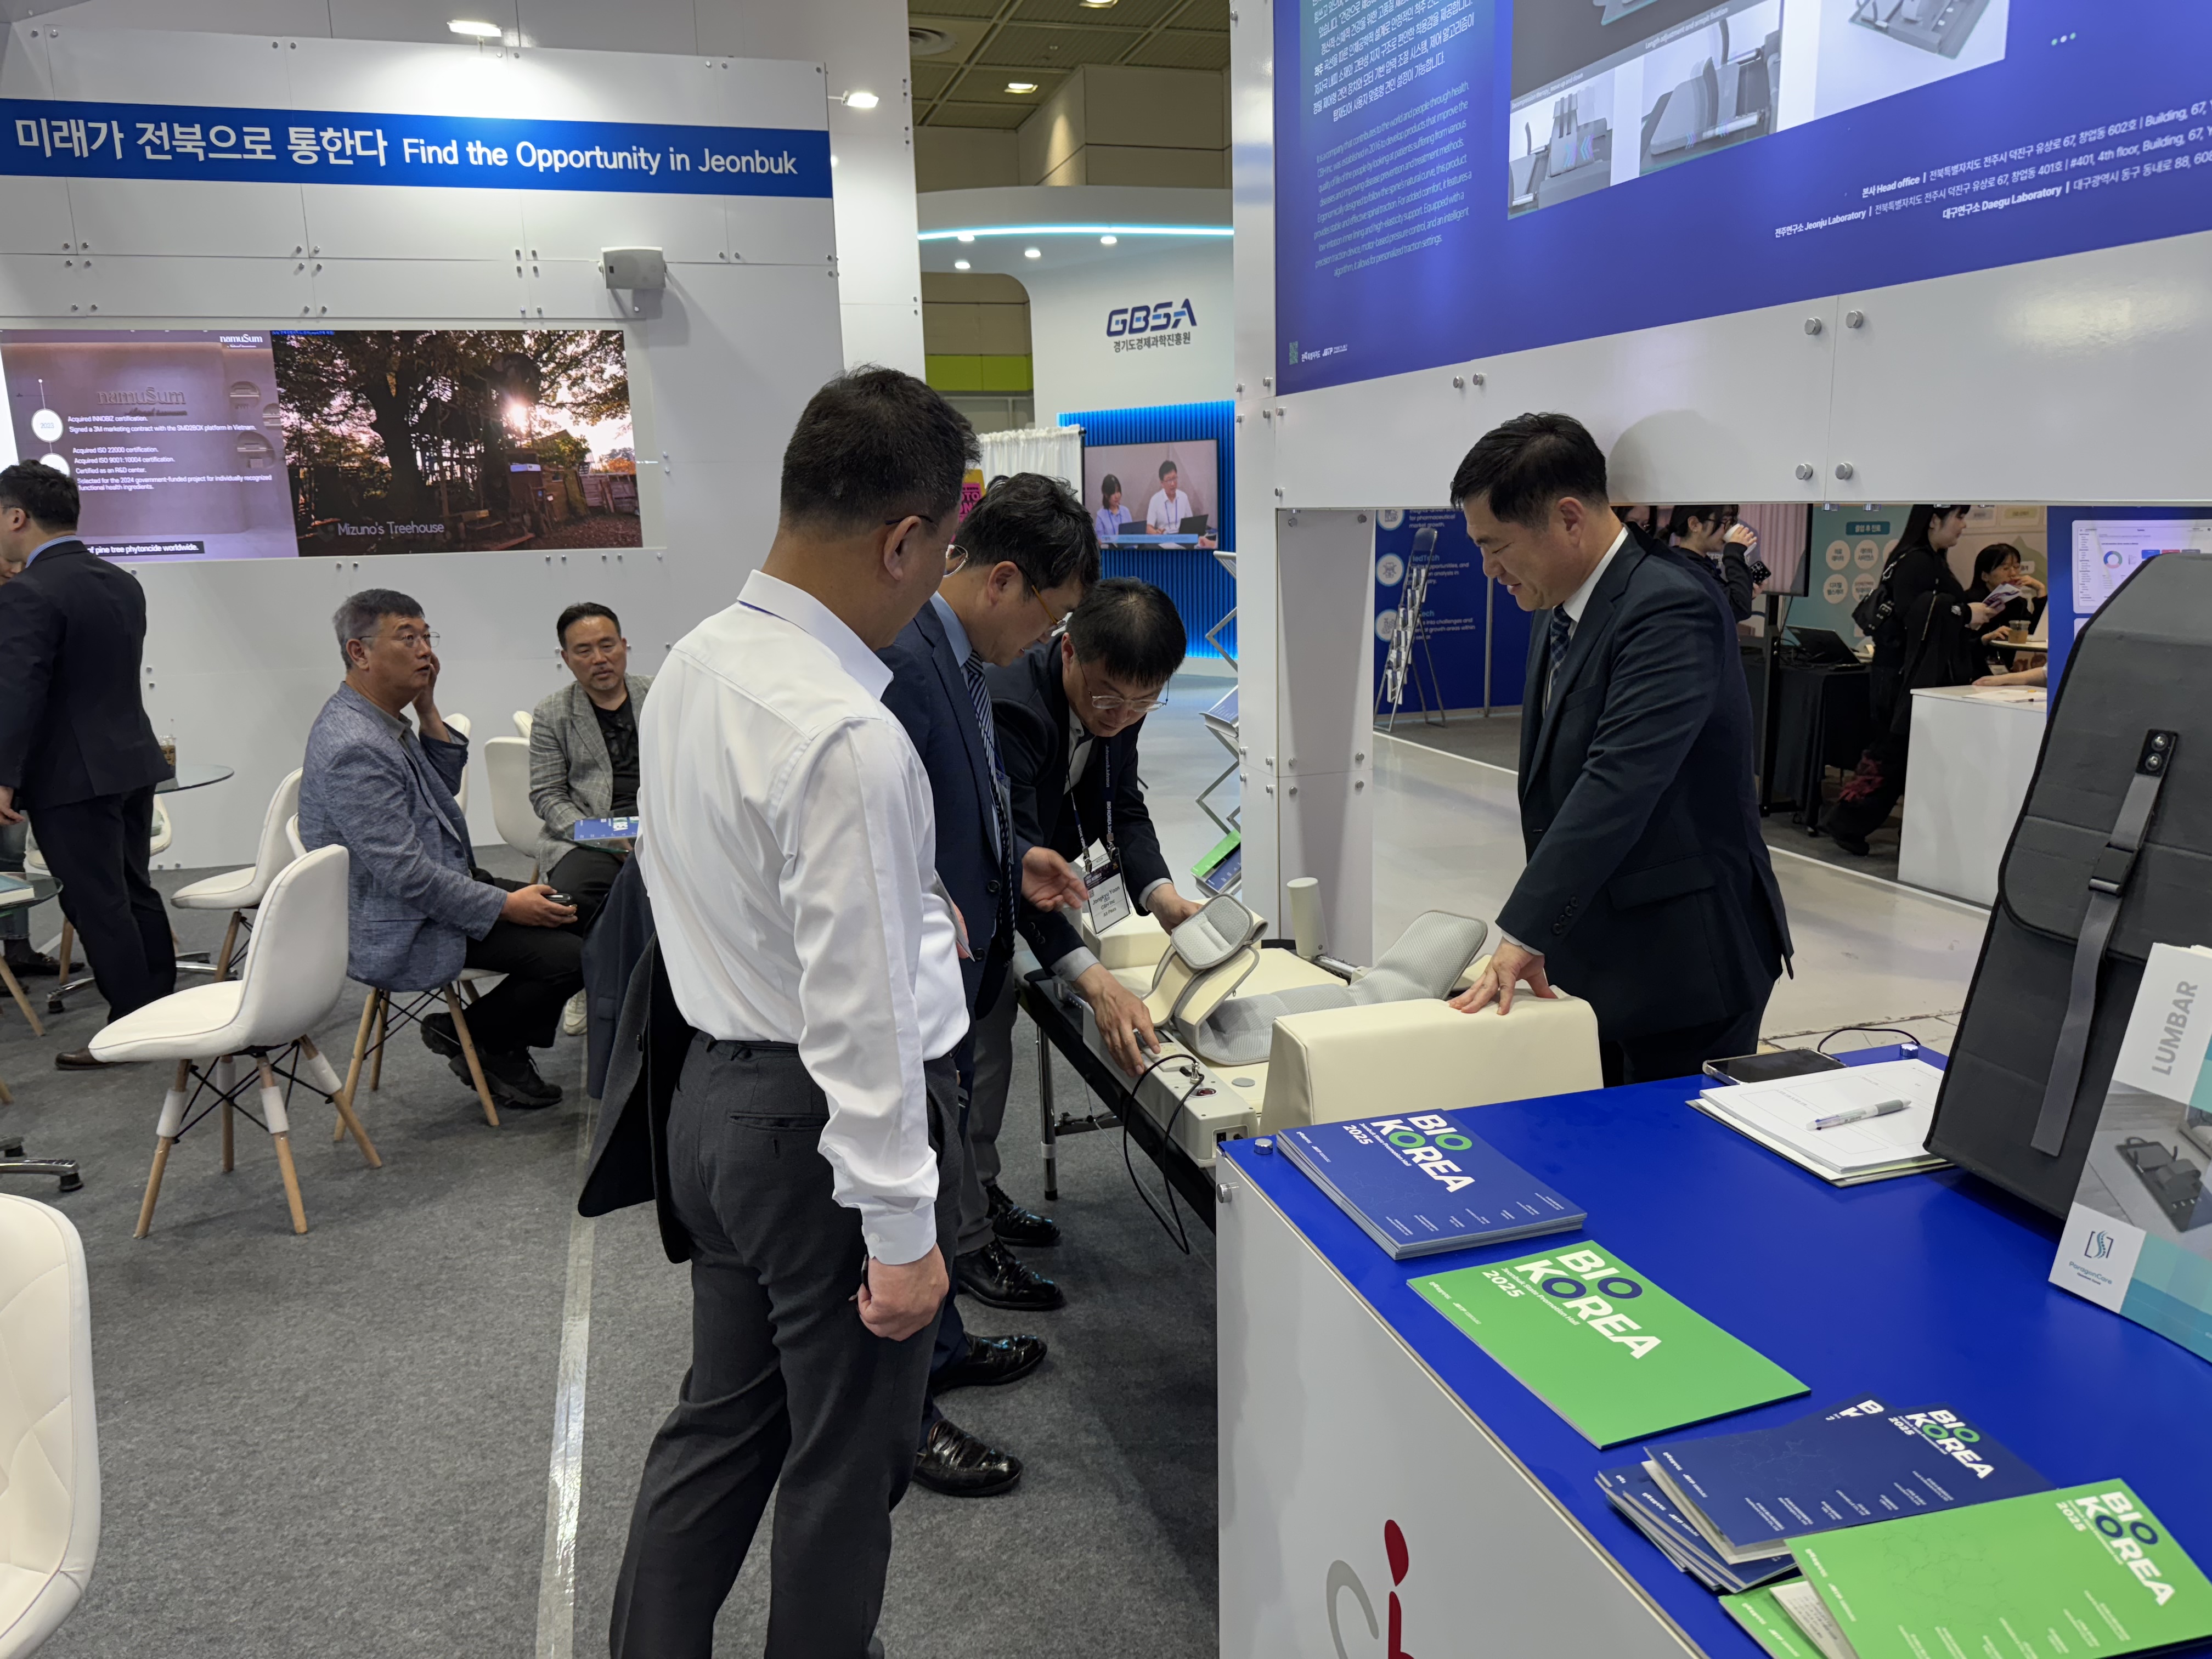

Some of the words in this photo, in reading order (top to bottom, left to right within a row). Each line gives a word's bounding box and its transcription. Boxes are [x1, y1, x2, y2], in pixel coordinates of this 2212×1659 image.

[1324, 53, 1338, 72] 곡선을
[1339, 46, 1348, 63] 따른
[1349, 30, 1373, 57] 인체공학적
[1374, 20, 1390, 42] 설계로
[1391, 5, 1413, 32] 안정적인
[1351, 15, 1365, 37] 건강을
[1367, 8, 1377, 27] 위한
[1353, 53, 1369, 74] 고탄성
[1380, 36, 1397, 58] 구조로
[1397, 25, 1414, 48] 편안한
[1415, 11, 1439, 37] 착용감을
[1363, 69, 1373, 87] 모터
[1374, 63, 1385, 81] 기반
[1385, 56, 1396, 75] 압력
[1397, 49, 1409, 68] 조절
[1409, 38, 1428, 63] 시스템,
[1429, 30, 1441, 50] 제어
[1442, 12, 1474, 43] 알고리즘이
[1352, 92, 1368, 112] 사용자
[1368, 82, 1384, 104] 맞춤형
[1397, 66, 1413, 89] 설정이
[1414, 49, 1445, 80] 가능합니다.
[1413, 100, 1429, 119] people
[1430, 88, 1451, 108] through
[15, 117, 123, 160] 미래가
[137, 122, 276, 161] 전북으로
[287, 127, 387, 166] 통한다
[403, 139, 458, 165] Find
[467, 141, 507, 166] the
[516, 141, 661, 175] Opportunity
[669, 148, 690, 172] in
[698, 149, 798, 175] Jeonbuk
[1369, 139, 1380, 154] 2016
[1404, 120, 1425, 139] products
[1459, 98, 1468, 112] the
[1862, 185, 1875, 199] 본사
[1876, 179, 1897, 194] Head
[1897, 173, 1920, 189] office
[1929, 157, 1981, 182] 전북특별자치도
[1983, 151, 2007, 168] 전주시
[2009, 144, 2034, 162] 덕진구
[2036, 137, 2061, 155] 유상로
[2063, 133, 2076, 149] 67,
[2079, 125, 2106, 145] 창업동
[2107, 118, 2137, 137] 602호
[2145, 104, 2188, 131] Building,
[1446, 152, 1466, 173] product
[1775, 221, 1804, 239] 전주연구소
[1804, 216, 1827, 233] Jeonju
[1827, 206, 1866, 228] Laboratory
[1875, 192, 1922, 216] 전북특별자치도
[1924, 187, 1946, 204] 전주시
[1948, 181, 1970, 199] 덕진구
[1972, 175, 1995, 193] 유상로
[1997, 172, 2008, 188] 67,
[2038, 159, 2063, 177] 401호
[2070, 152, 2095, 171] #401,
[2097, 147, 2114, 163] 4th
[2116, 140, 2140, 160] floor,
[2142, 129, 2185, 155] Building,
[1943, 199, 1980, 221] 대구연구소
[1982, 193, 2010, 213] Daegu
[2011, 182, 2062, 208] Laboratory
[2073, 168, 2119, 193] 대구광역시
[2121, 165, 2140, 182] 동구
[2142, 157, 2172, 177] 동내로
[219, 334, 263, 343] namuSum
[1107, 298, 1197, 337] GBSA
[1114, 331, 1190, 353] 경기도경제과학진흥원
[95, 546, 110, 555] pine
[126, 545, 161, 554] phytoncide
[163, 543, 199, 551] worldwide.
[338, 523, 385, 537] Mizuno's
[387, 521, 444, 534] Treehouse
[2152, 980, 2197, 1076] LUMBAR
[1342, 1125, 1374, 1144] 2025
[1370, 1119, 1475, 1193] KOREA
[1407, 1114, 1472, 1150] BIO
[1482, 1270, 1526, 1297] 2025
[1500, 1267, 1525, 1286] Jeonbuk
[1537, 1294, 1567, 1318] Promotion
[1565, 1316, 1581, 1325] Hall
[1555, 1249, 1643, 1299] BIO
[2069, 1261, 2112, 1284] ParagonCare
[1514, 1259, 1662, 1359] KOREA
[1888, 1417, 1915, 1435] 2025
[1905, 1413, 1994, 1479] KOREA
[1928, 1410, 1980, 1442] BIO
[2056, 1502, 2086, 1532] 2025
[2100, 1491, 2158, 1545] BIO
[2075, 1496, 2175, 1606] KOREA
